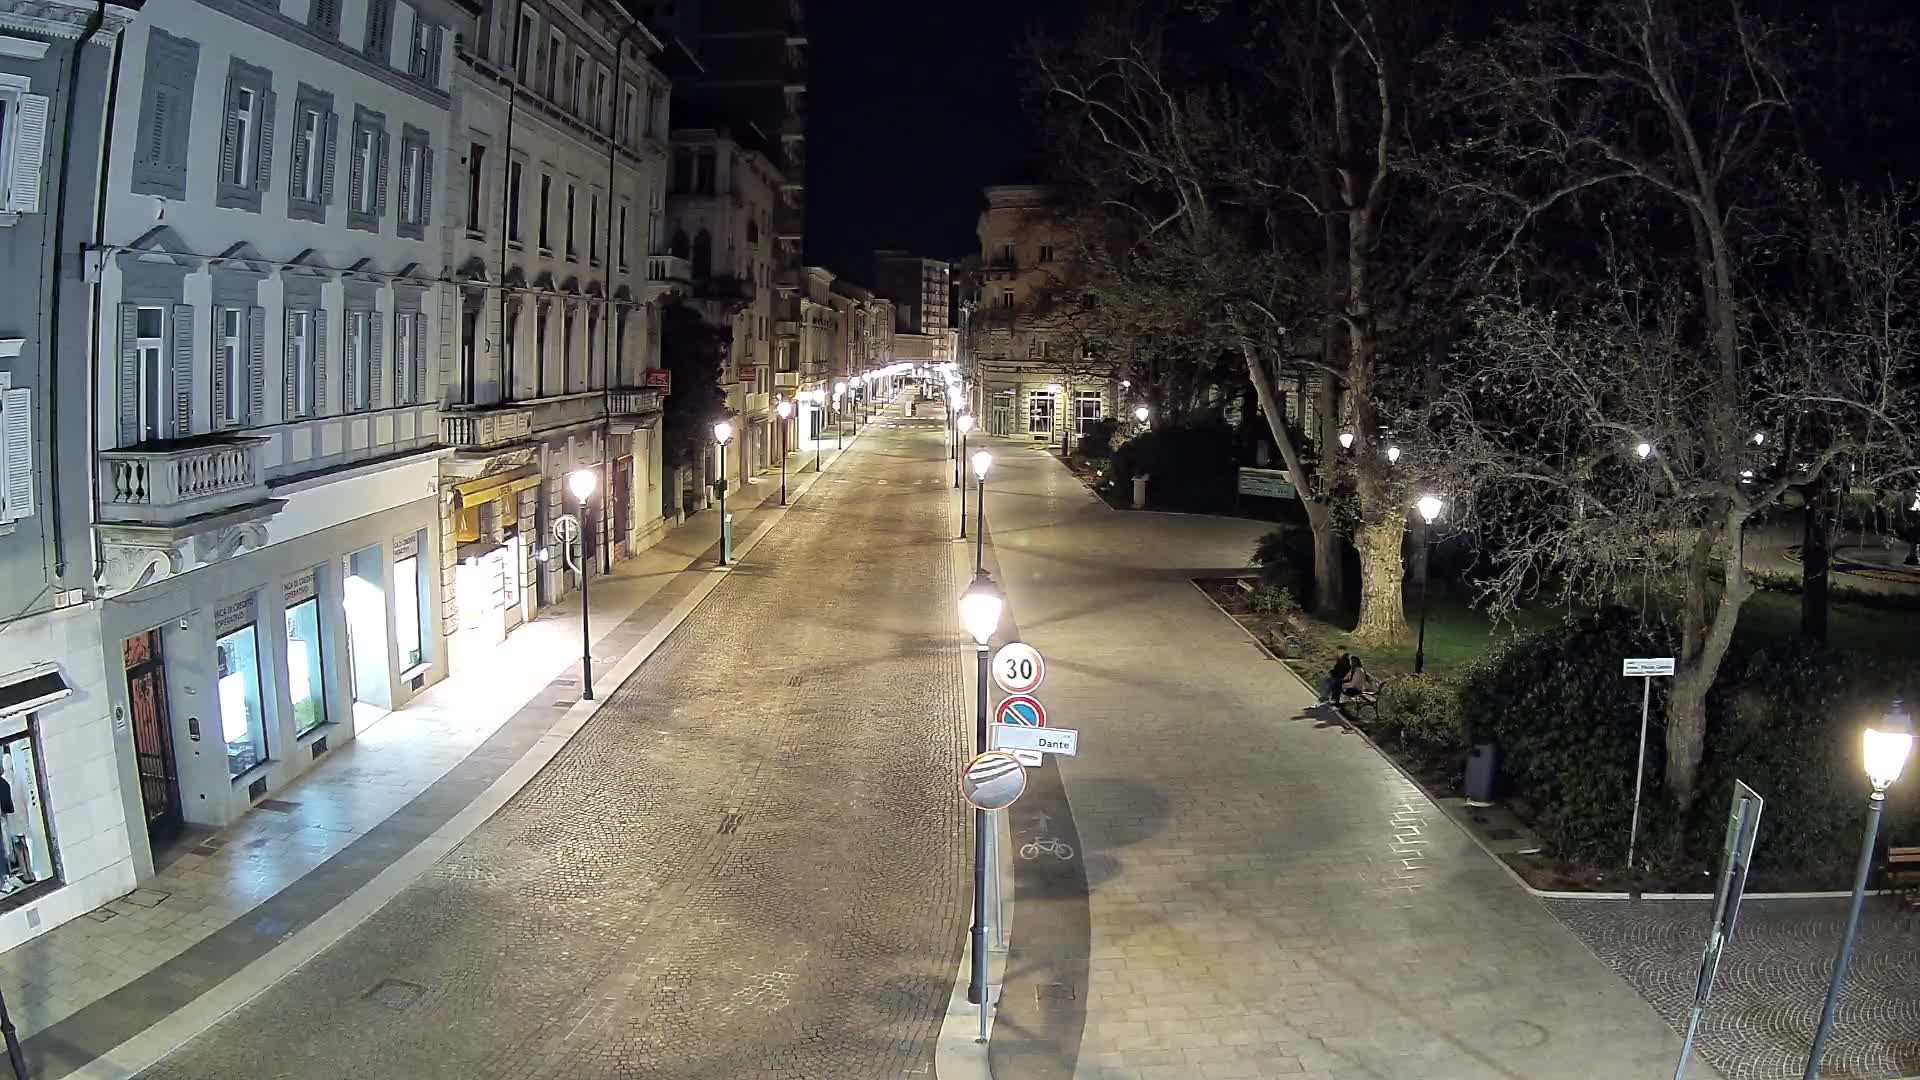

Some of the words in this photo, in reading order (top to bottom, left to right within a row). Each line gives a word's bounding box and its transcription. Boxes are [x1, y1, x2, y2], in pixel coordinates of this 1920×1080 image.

[285, 585, 308, 600] OPERATIVO
[216, 611, 245, 626] OPERATIVO
[1006, 658, 1032, 680] 30
[1038, 738, 1070, 749] Dante
